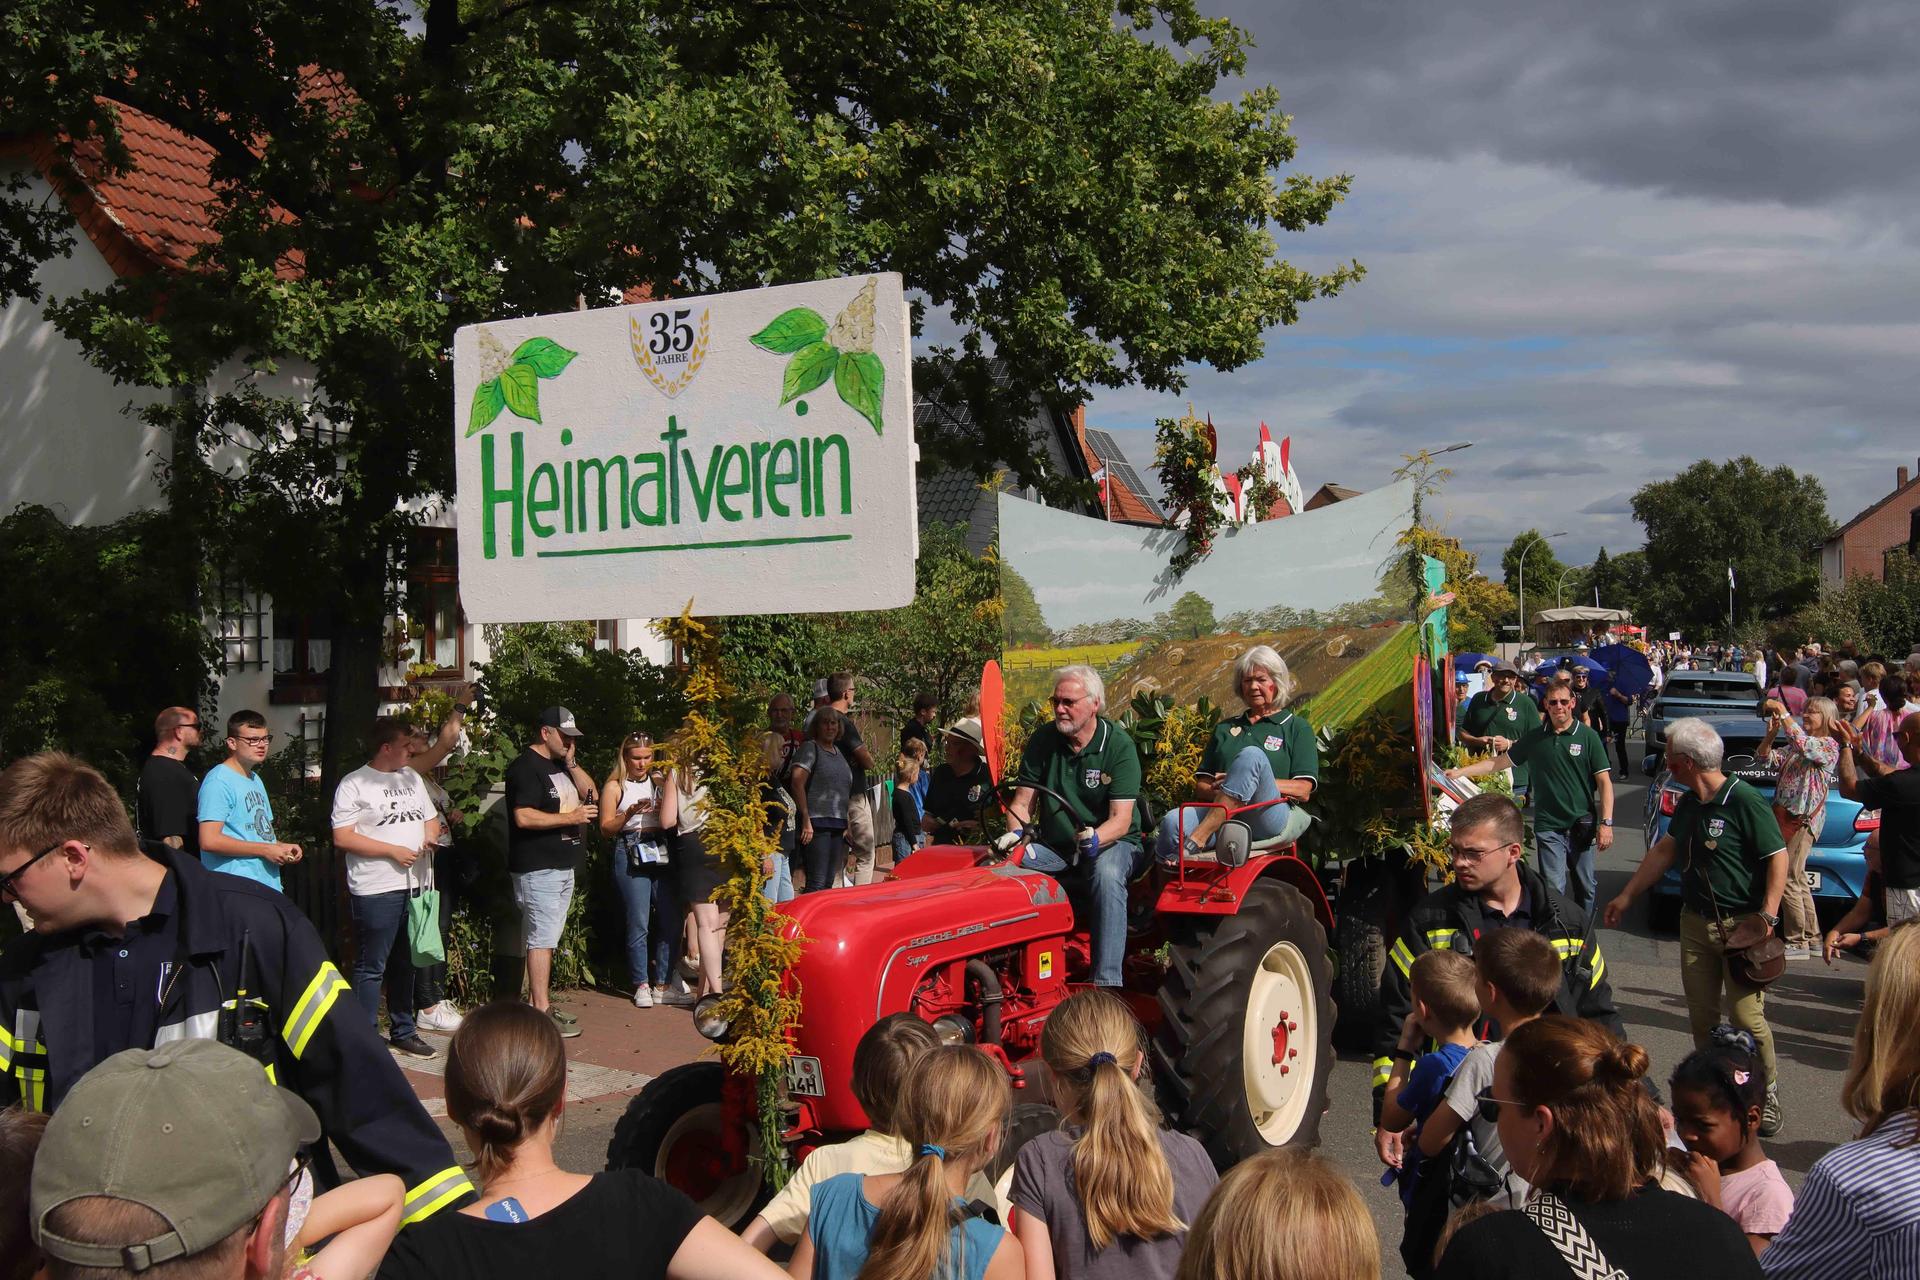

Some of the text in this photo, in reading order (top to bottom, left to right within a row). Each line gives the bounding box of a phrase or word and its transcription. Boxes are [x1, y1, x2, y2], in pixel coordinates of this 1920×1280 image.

[649, 308, 694, 354] 35
[655, 351, 689, 365] JAHRE
[481, 400, 852, 560] Heimatverein
[383, 786, 416, 798] PEANUTS
